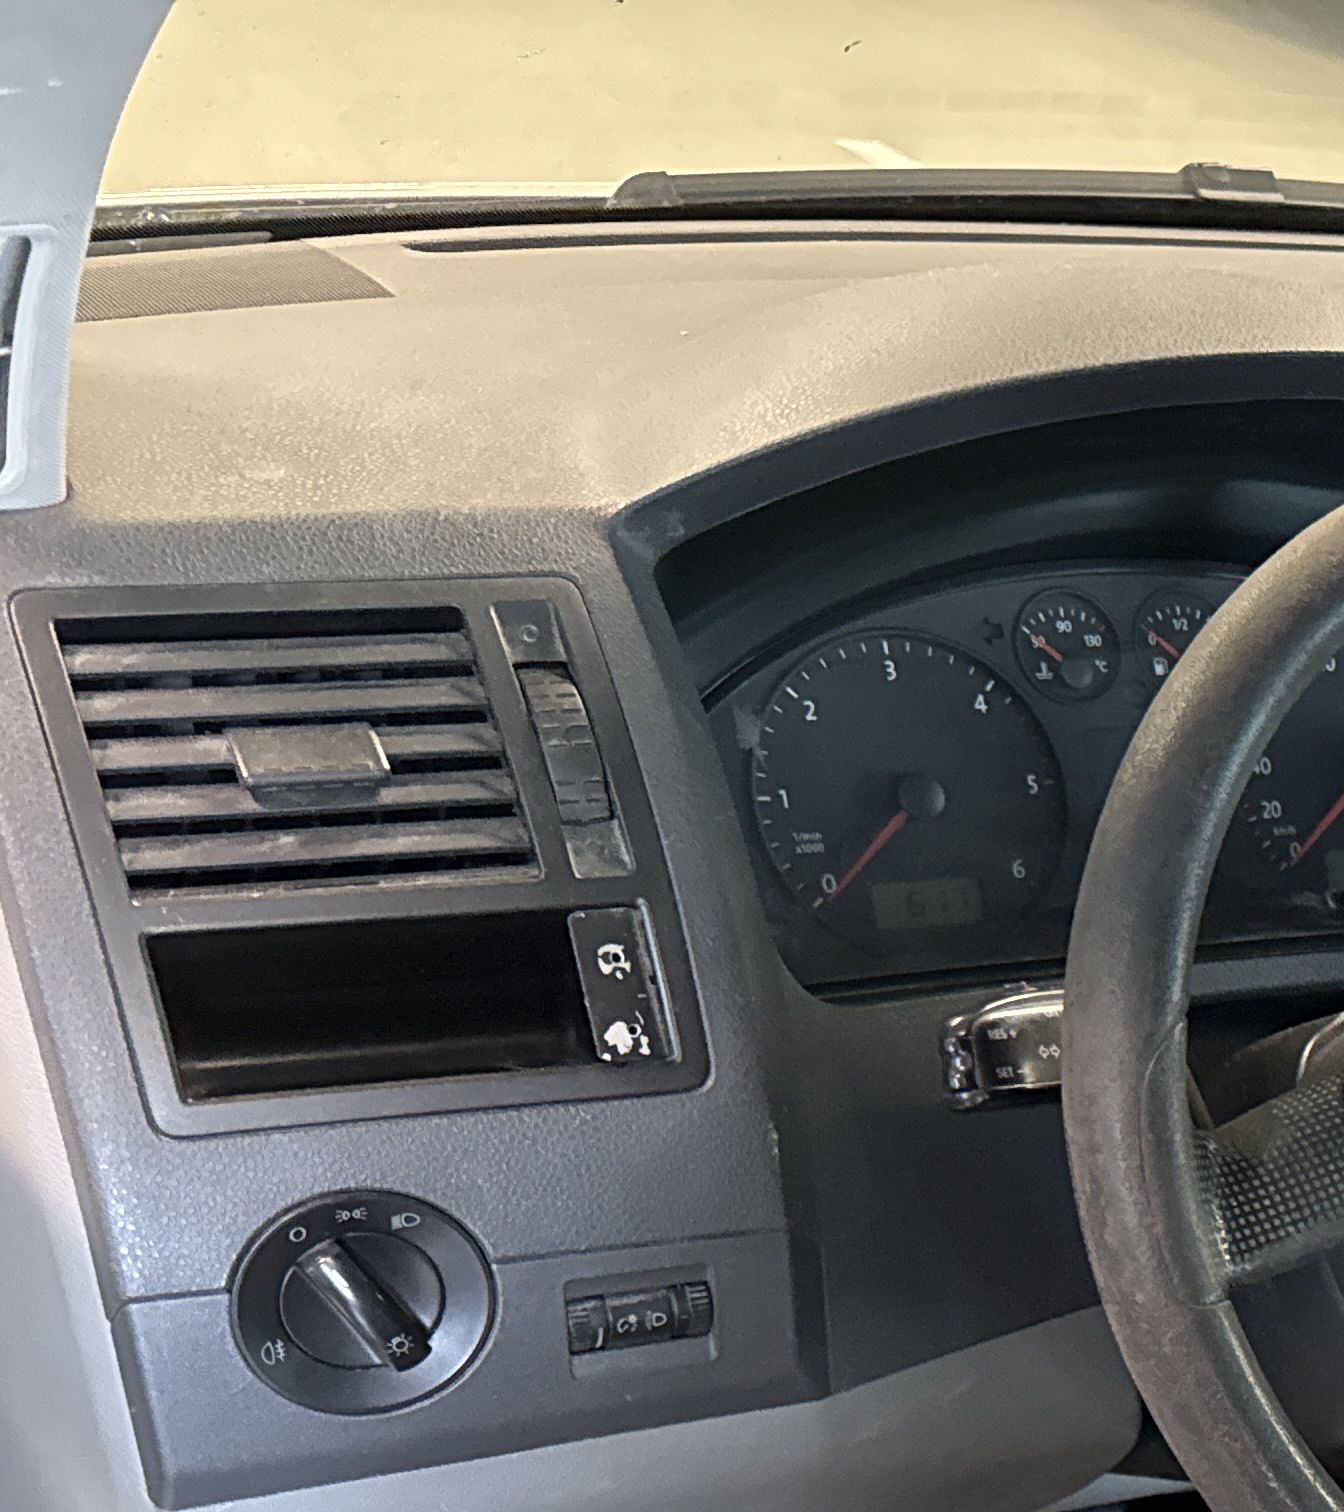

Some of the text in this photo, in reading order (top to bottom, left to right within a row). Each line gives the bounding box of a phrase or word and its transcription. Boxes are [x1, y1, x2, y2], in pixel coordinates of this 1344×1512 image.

[1056, 620, 1073, 633] 90
[1172, 618, 1189, 632] 1/2
[1083, 634, 1103, 647] 130
[1147, 631, 1157, 645] 0
[883, 659, 897, 681] 3
[803, 700, 818, 721] 2
[974, 693, 989, 714] 4
[1027, 774, 1039, 795] 5
[778, 789, 789, 809] 1
[1261, 800, 1282, 819] 20
[1289, 841, 1302, 858] 0
[1011, 859, 1026, 879] 6
[821, 873, 837, 894] 0
